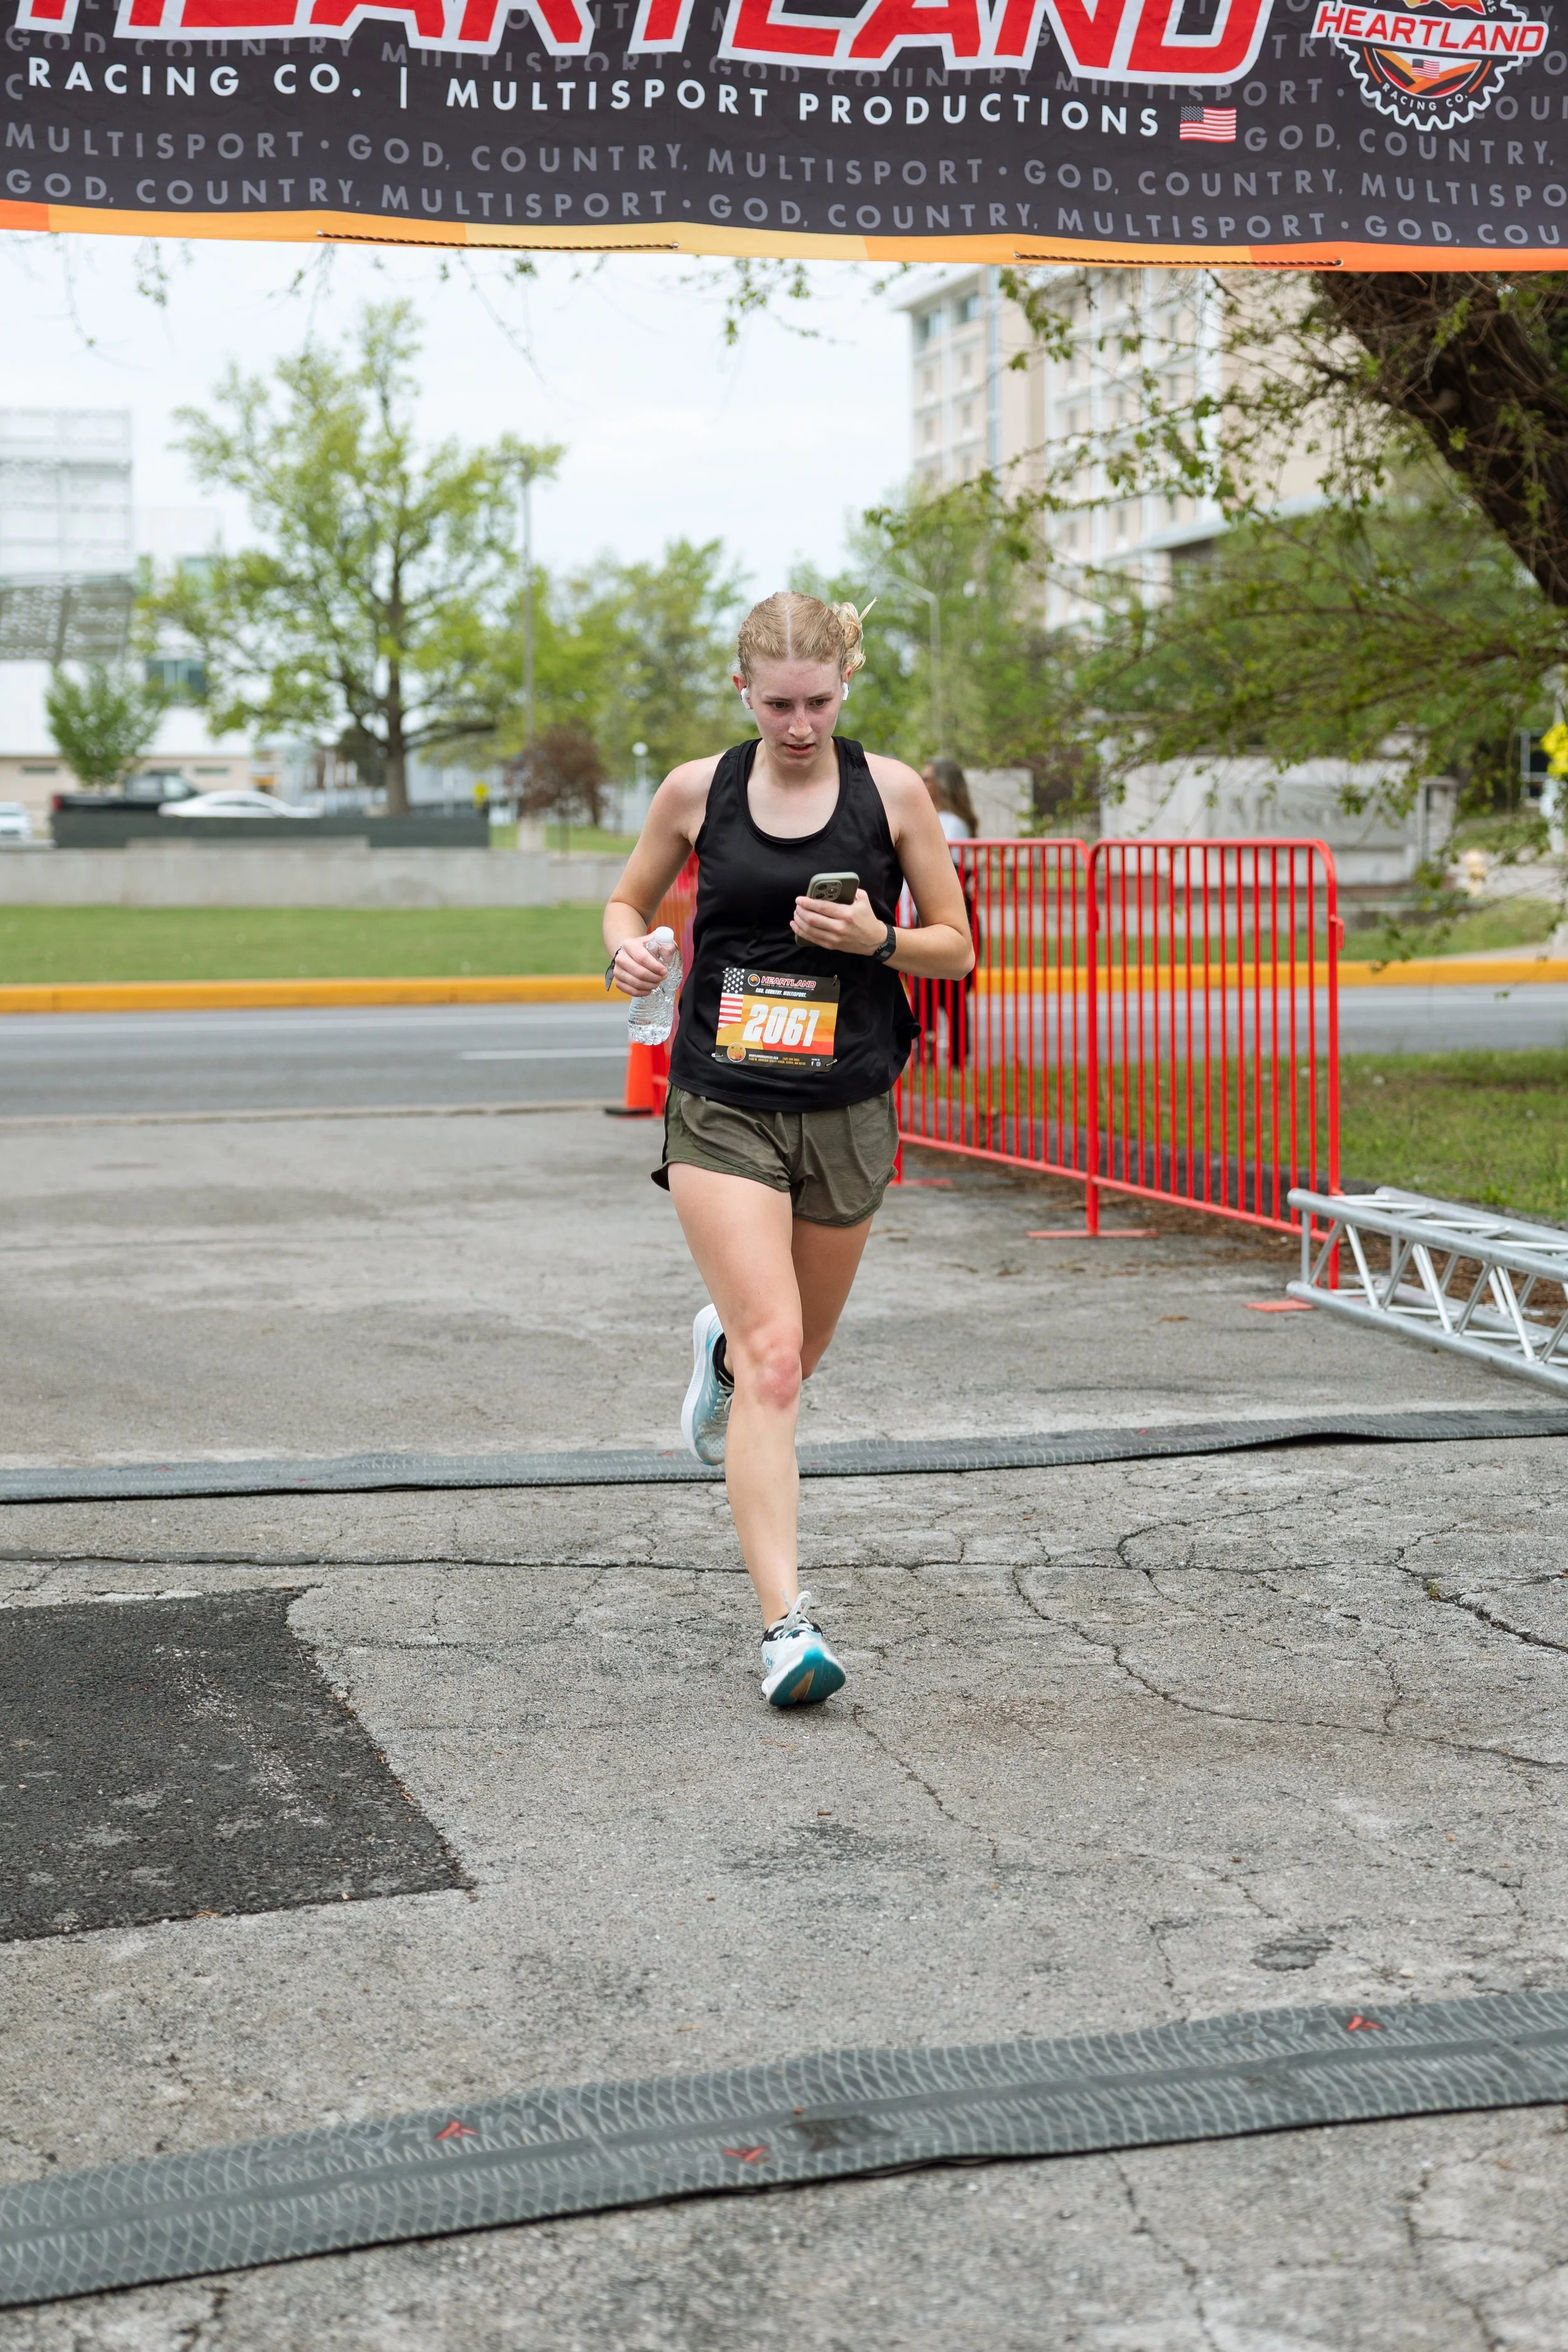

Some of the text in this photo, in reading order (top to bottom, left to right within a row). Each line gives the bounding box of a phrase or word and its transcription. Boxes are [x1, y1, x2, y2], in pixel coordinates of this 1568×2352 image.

[1317, 6, 1545, 53] HEARTLAND
[29, 57, 1158, 137] RACING CO. MULTISPORT PRODUCTIONS
[1382, 82, 1437, 111] RACING
[1446, 93, 1468, 108] CO.
[5, 122, 304, 159] MULTISPORT
[347, 134, 450, 171] GOD,
[471, 144, 688, 173] COUNTRY,
[707, 148, 982, 186] MULTISPORT
[1024, 159, 1119, 195] GOD,
[1138, 168, 1343, 198] COUNTRY,
[1244, 124, 1554, 166] GOD, COUNTRY,
[6, 168, 115, 204] GOD,
[135, 177, 361, 208] COUNTRY,
[381, 184, 667, 219] MULTISPORT
[708, 194, 808, 228] GOD,
[827, 203, 1039, 231] COUNTRY,
[1057, 207, 1325, 239] MULTISPORT
[761, 976, 816, 988] HEARTLAND
[742, 1004, 820, 1046] 2061
